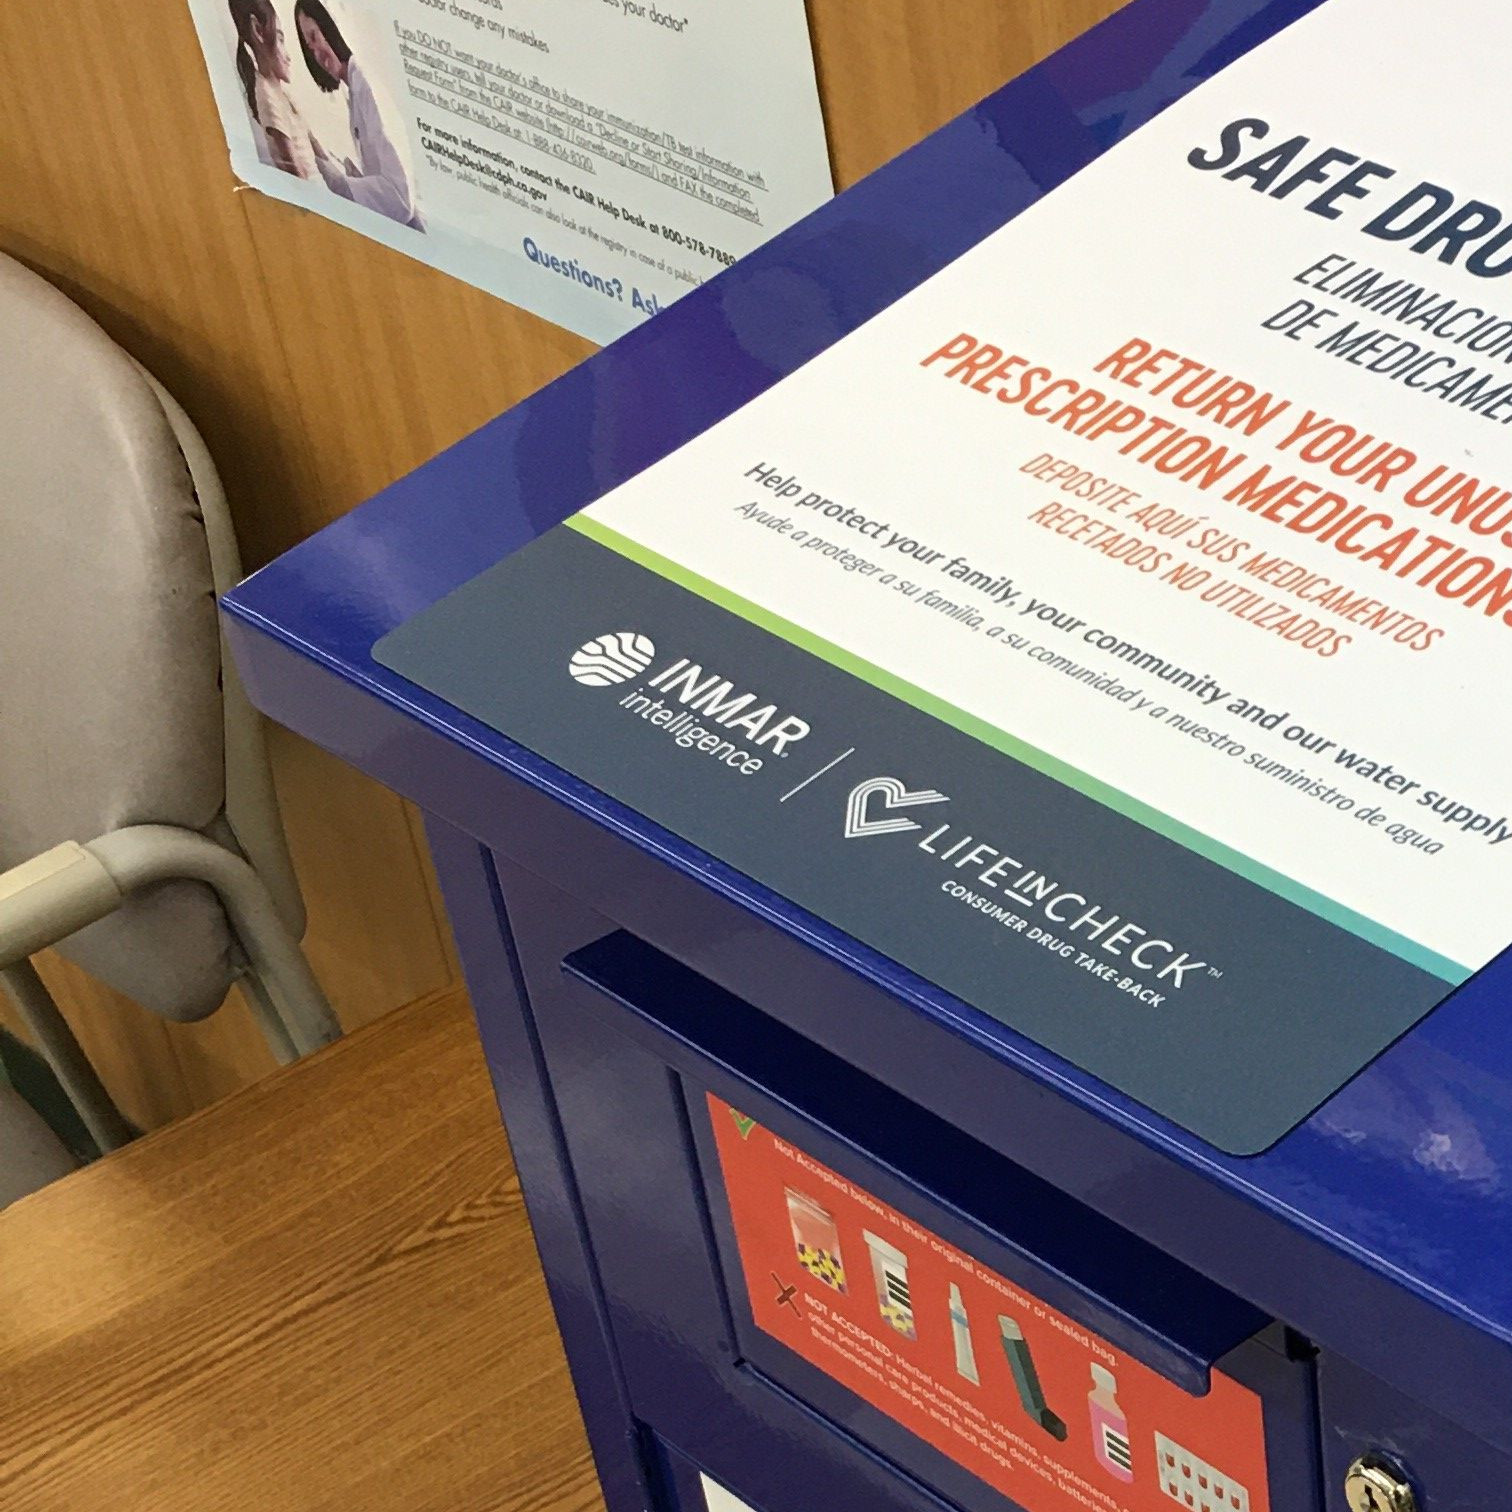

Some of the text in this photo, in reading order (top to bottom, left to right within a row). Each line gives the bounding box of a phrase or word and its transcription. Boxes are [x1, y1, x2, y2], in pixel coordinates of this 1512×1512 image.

[416, 117, 432, 134] For
[433, 128, 459, 147] more
[554, 178, 571, 195] the
[571, 185, 595, 206] CAIR
[596, 196, 620, 219] Help
[621, 207, 647, 229] Desk
[648, 223, 660, 235] at
[1186, 118, 1396, 221] SAFE
[522, 236, 623, 302] Questions?
[1260, 299, 1339, 342] DE
[919, 333, 1247, 491] PRESCRIPTION
[1092, 337, 1292, 437] RETURN
[1275, 410, 1417, 493] YOUR
[1019, 453, 1444, 651] DEPOSITE AQUÍ SUS MEDICAMENTOS
[1028, 502, 1352, 658] RECETADOS NO UTILIZADOS
[734, 502, 1444, 856] Ayude a proteger a su familia, a su comunidad y a nuestro suministro de agua
[743, 462, 802, 498] Help
[794, 492, 889, 540] protect
[880, 533, 945, 565] your
[940, 557, 1021, 607] family,
[1018, 599, 1086, 633] your
[1083, 629, 1230, 705] community
[1226, 699, 1290, 731] and
[1282, 726, 1337, 755] our
[1334, 749, 1420, 795] water
[619, 688, 762, 775] intelligence
[647, 658, 810, 755] INMAR
[941, 880, 1165, 1008] CONSUMER DRUG TAKE-BACK
